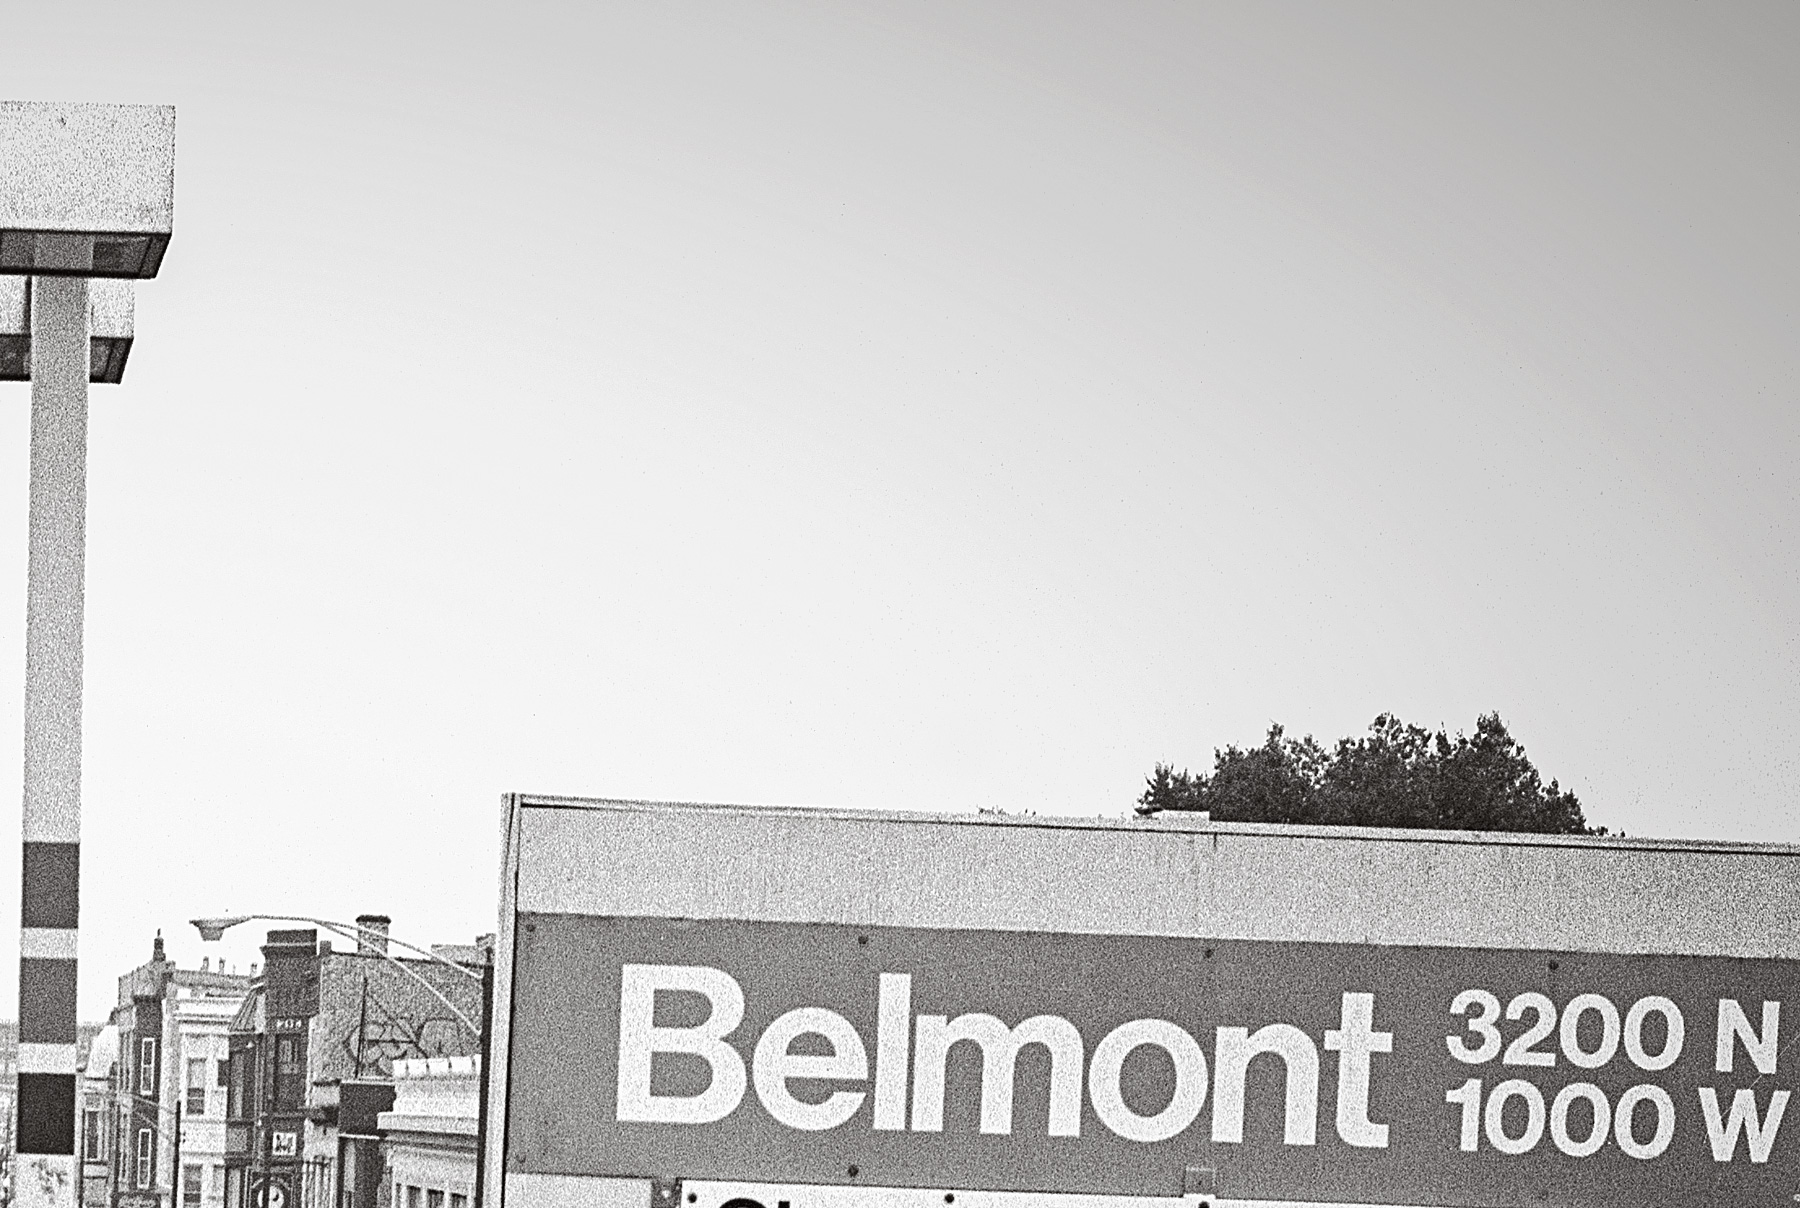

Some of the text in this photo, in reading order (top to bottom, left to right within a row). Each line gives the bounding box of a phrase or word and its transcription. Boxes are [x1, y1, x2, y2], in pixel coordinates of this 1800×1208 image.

[616, 964, 1392, 1147] Belmont
[1446, 989, 1780, 1074] 3200 N
[1446, 1079, 1790, 1163] 1000 W
